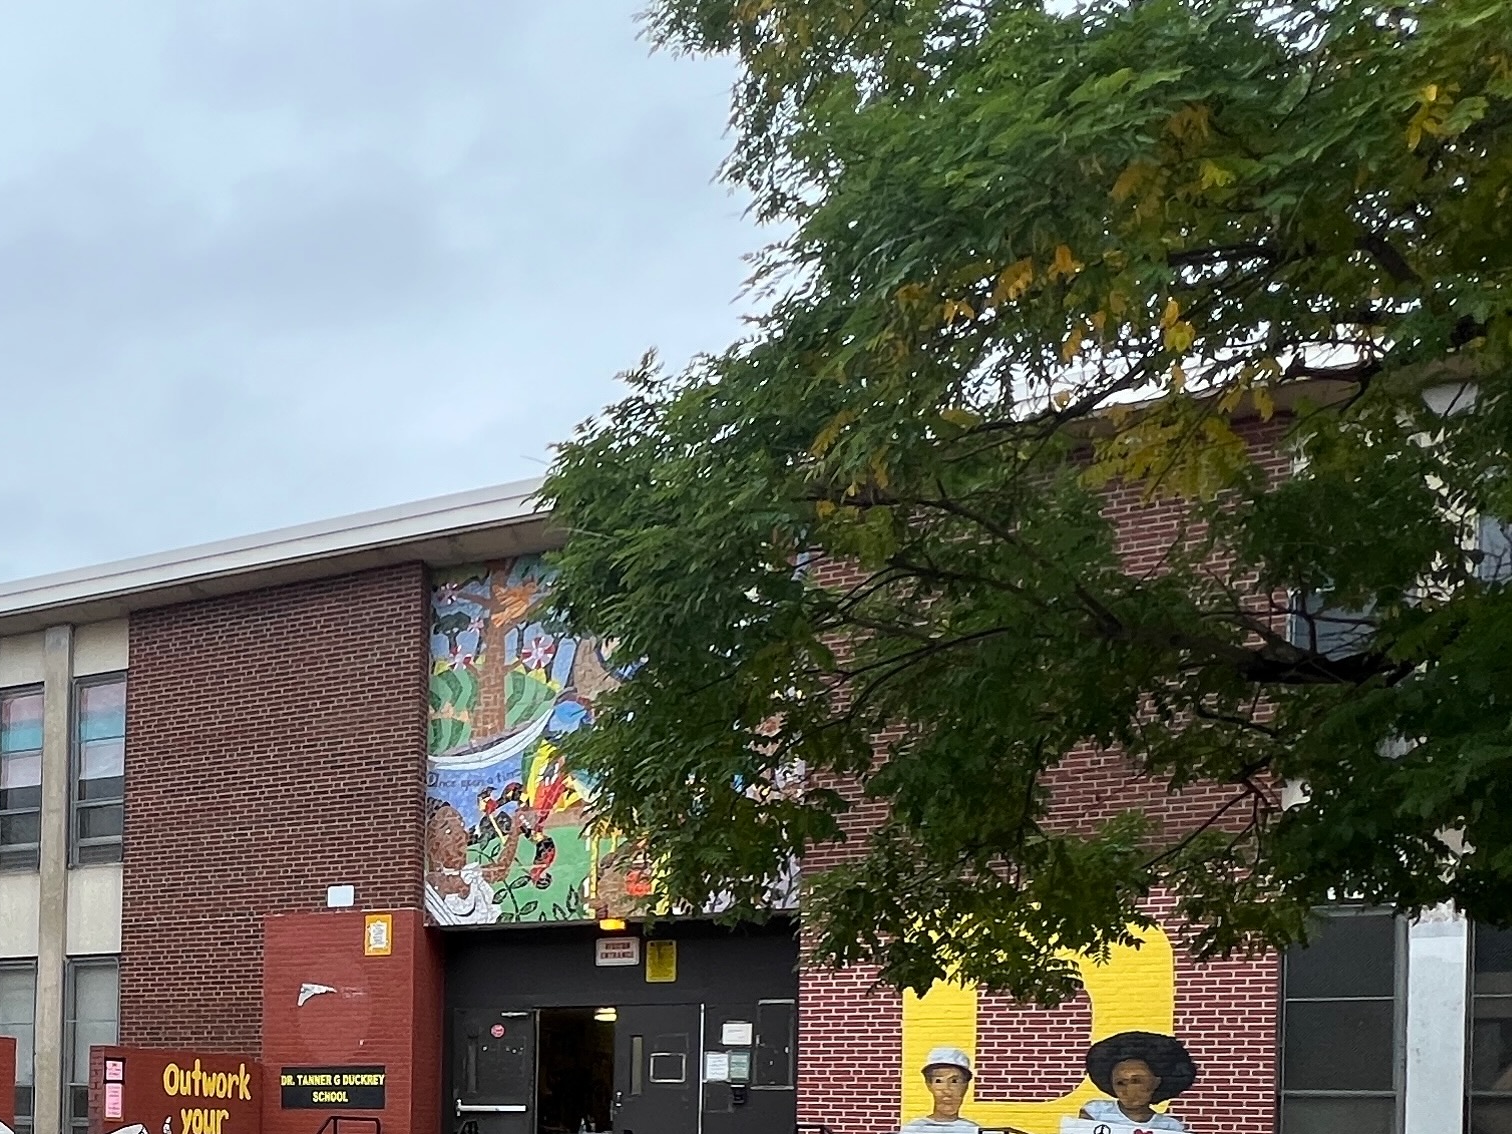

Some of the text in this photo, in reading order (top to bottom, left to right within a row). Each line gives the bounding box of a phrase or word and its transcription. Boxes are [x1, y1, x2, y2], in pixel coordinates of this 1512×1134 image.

[163, 1058, 252, 1101] Outwork
[281, 1074, 385, 1086] DR. TANNER G DUCKREY
[312, 1091, 349, 1103] SCHOOL
